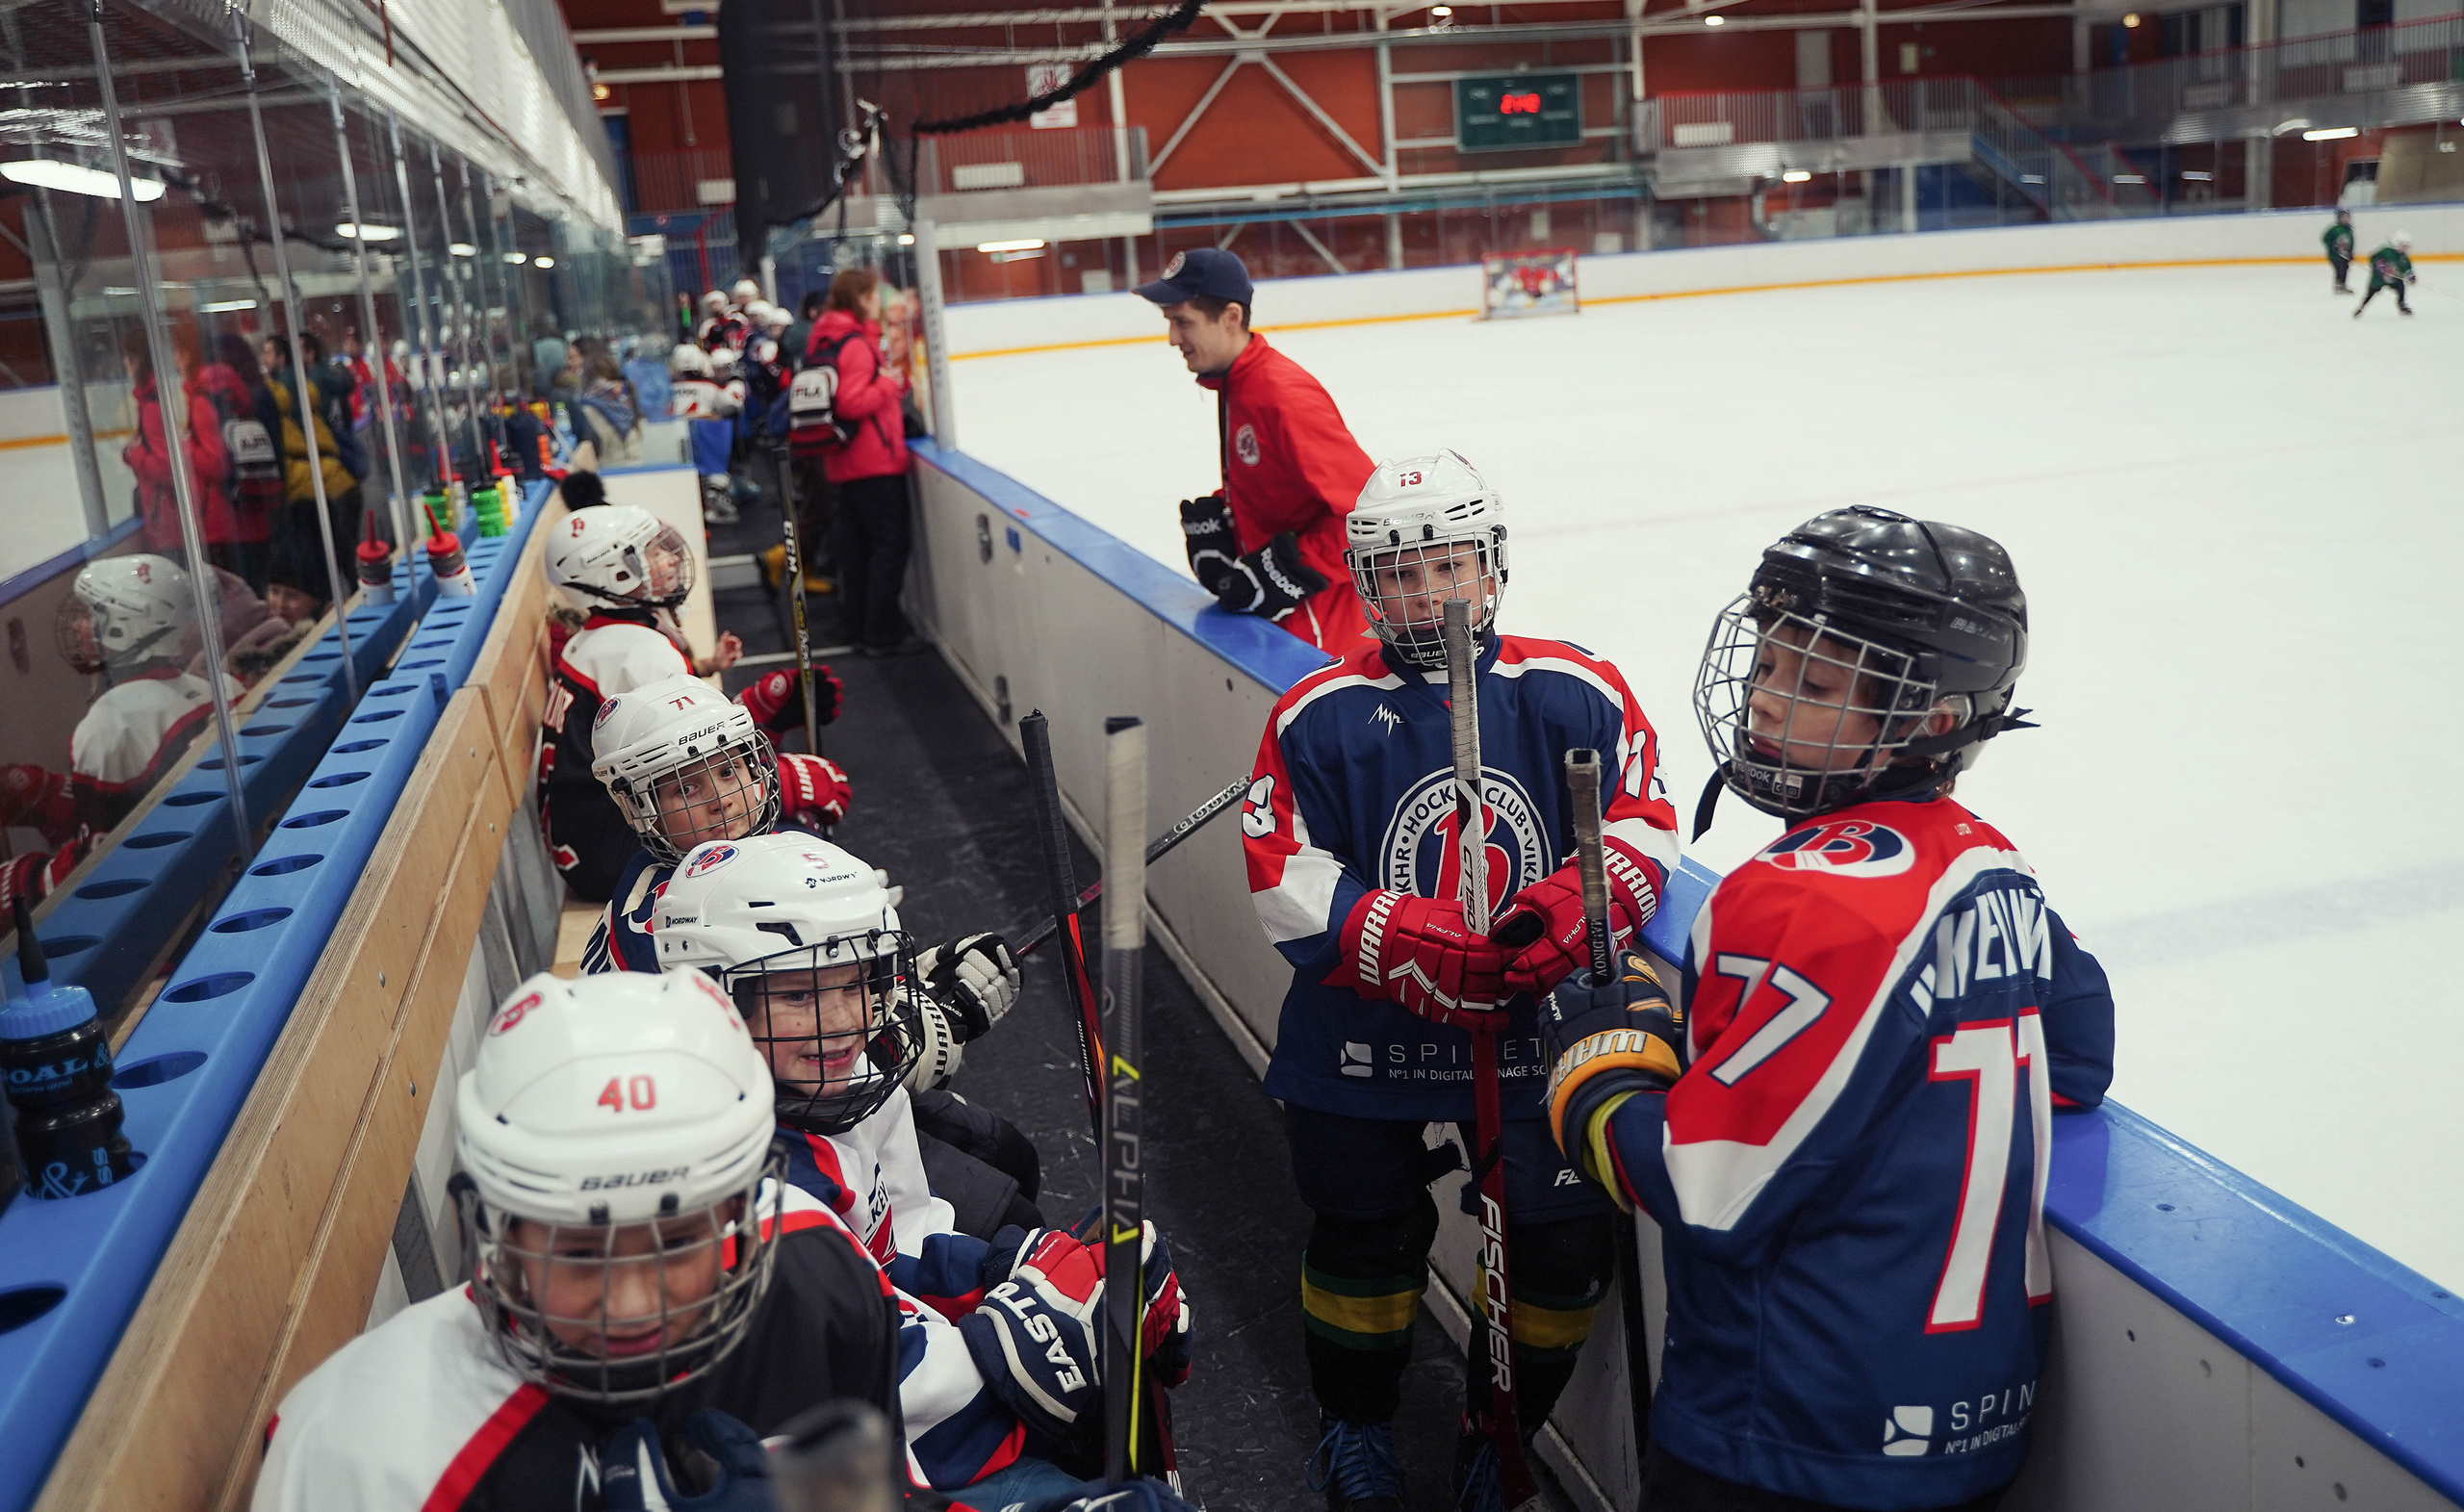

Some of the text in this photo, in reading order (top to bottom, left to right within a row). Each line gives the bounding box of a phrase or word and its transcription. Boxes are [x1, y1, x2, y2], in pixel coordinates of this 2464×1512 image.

[1400, 471, 1423, 487] 13
[783, 521, 798, 573] CCM
[1260, 547, 1306, 600] Reebok
[1411, 648, 1448, 658] BAUE
[669, 695, 695, 711] 71
[679, 721, 726, 746] BAUER
[1402, 784, 1527, 835] HOCK CLUB
[1603, 844, 1657, 927] ARRIOR
[1715, 951, 1835, 1089] 77
[1413, 1068, 1426, 1079] IN
[598, 1075, 656, 1113] 40
[1113, 1055, 1141, 1244] ALPHA
[579, 1166, 690, 1192] BAUER
[1479, 1192, 1513, 1393] FISCHER
[1969, 1436, 1981, 1451] IN
